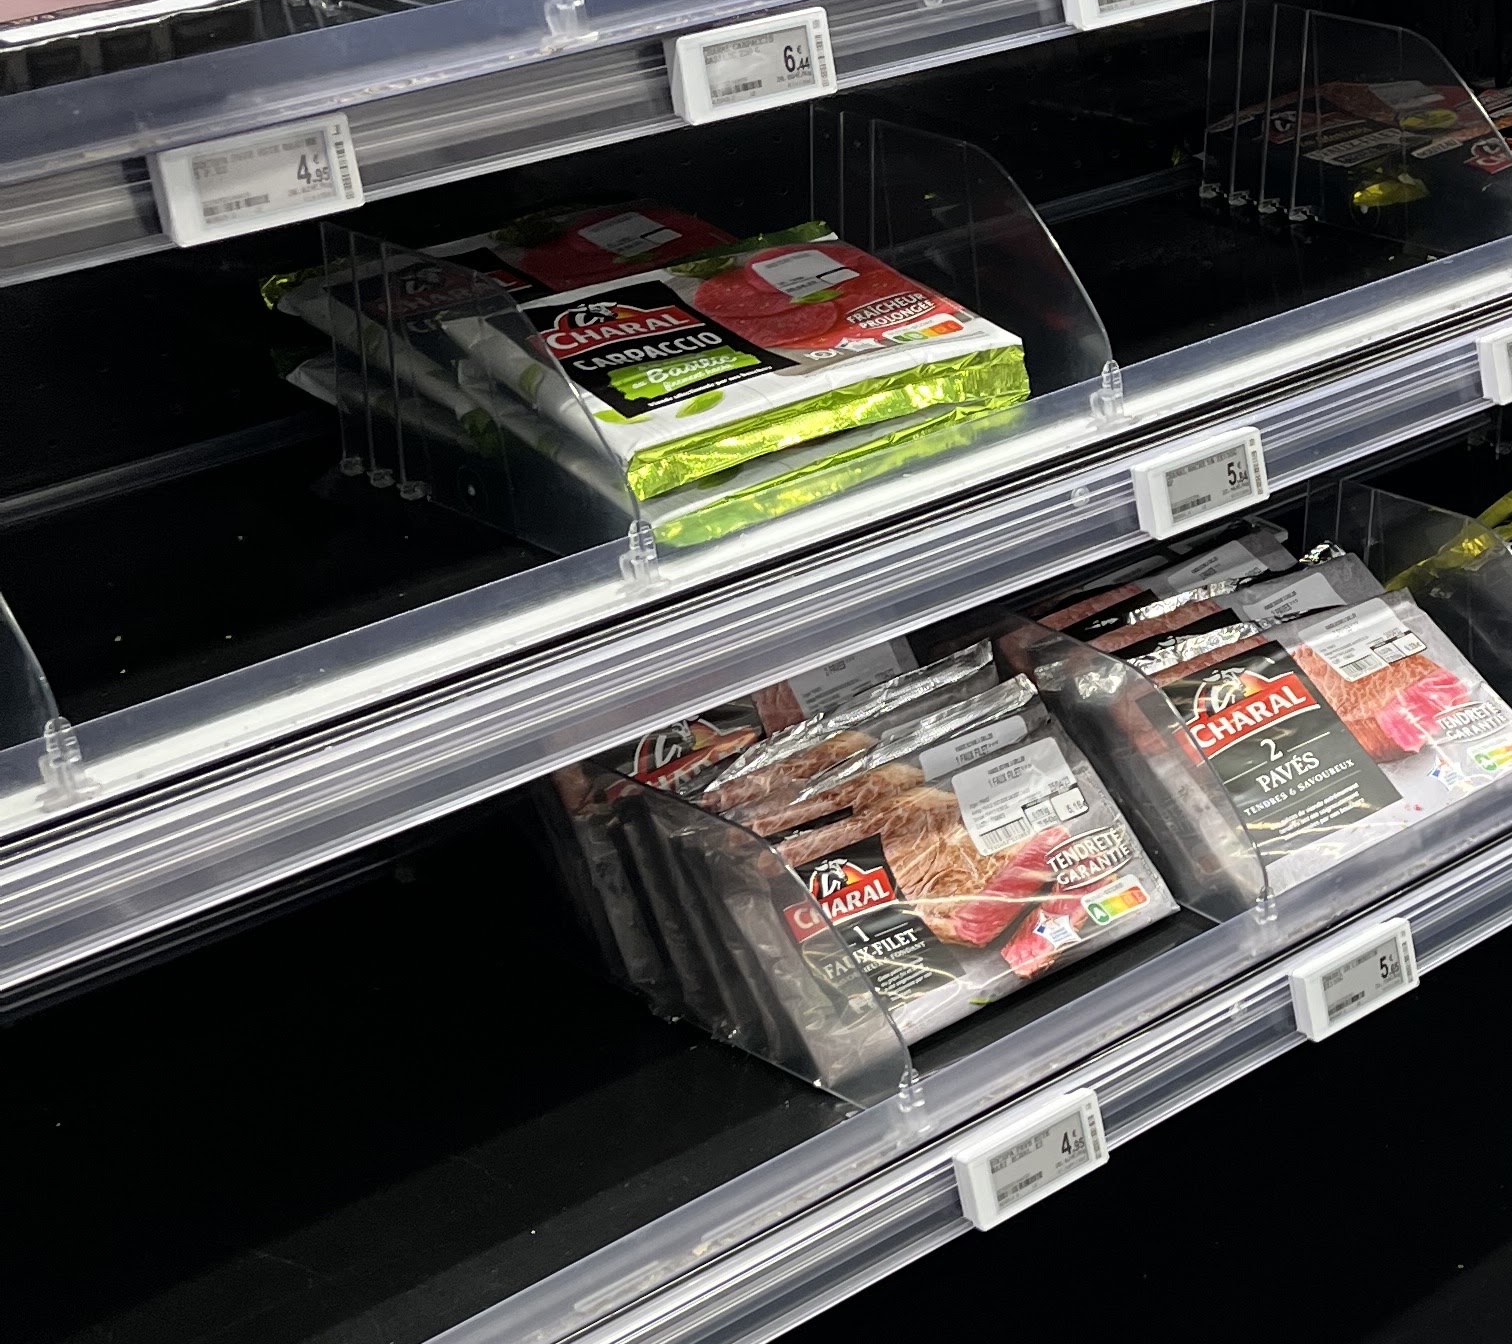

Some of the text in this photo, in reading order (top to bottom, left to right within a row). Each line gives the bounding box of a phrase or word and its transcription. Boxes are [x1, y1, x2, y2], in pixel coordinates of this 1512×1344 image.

[545, 311, 690, 350] CHARAL
[573, 331, 723, 372] CARPACCIO
[645, 354, 737, 385] Basilic
[1189, 685, 1307, 748] CHARAL
[1260, 737, 1284, 762] 2
[1244, 791, 1288, 817] TENDRES
[1299, 758, 1355, 793] SAVOUREUX
[1255, 751, 1320, 793] PAVÉS
[1047, 827, 1124, 873] TENDRETÉ
[1056, 845, 1130, 885] GARANTIE
[793, 879, 890, 930] CHARAL
